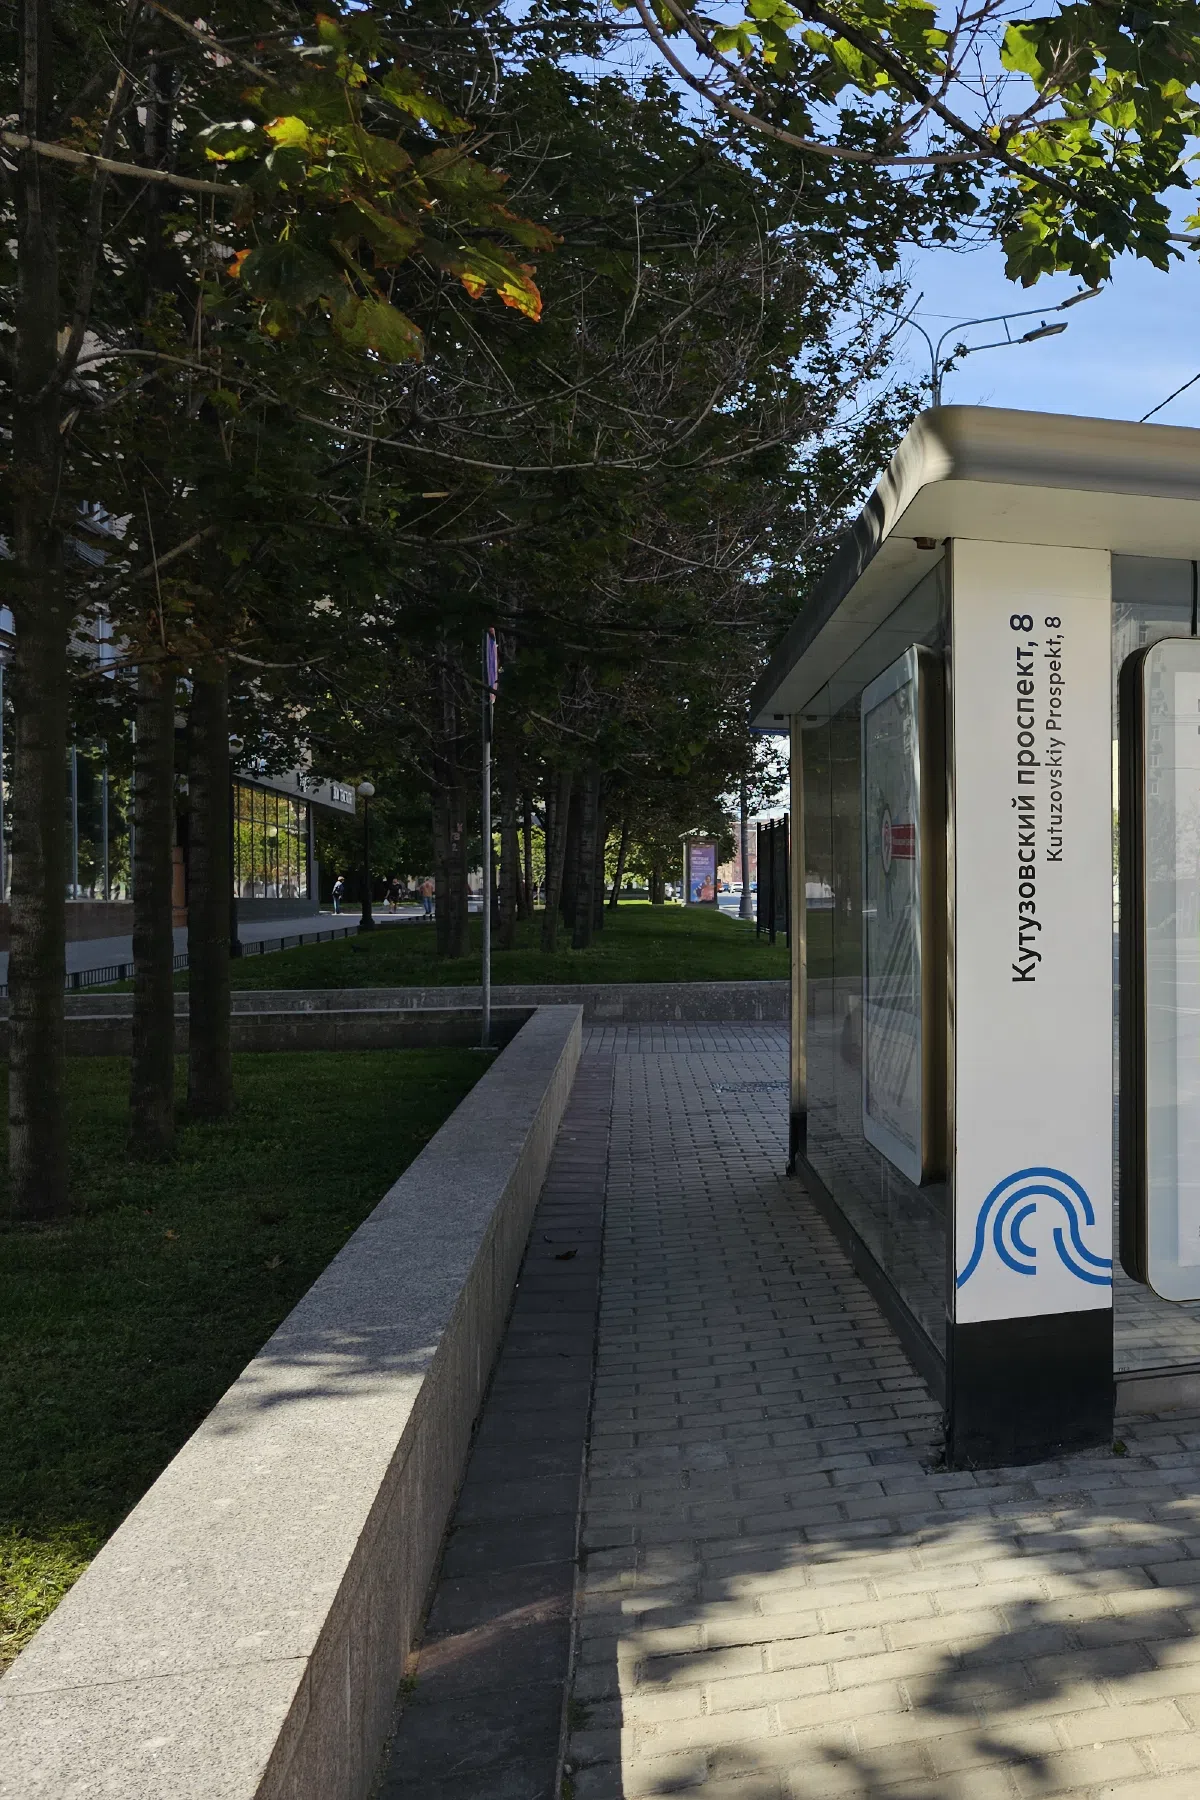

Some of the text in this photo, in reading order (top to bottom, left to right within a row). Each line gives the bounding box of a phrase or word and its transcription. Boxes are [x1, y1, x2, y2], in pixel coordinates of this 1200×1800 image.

[1010, 613, 1042, 982] Кутузовский проспект, 8
[1044, 616, 1066, 862] Kutuzovskiy Prospekt, 8
